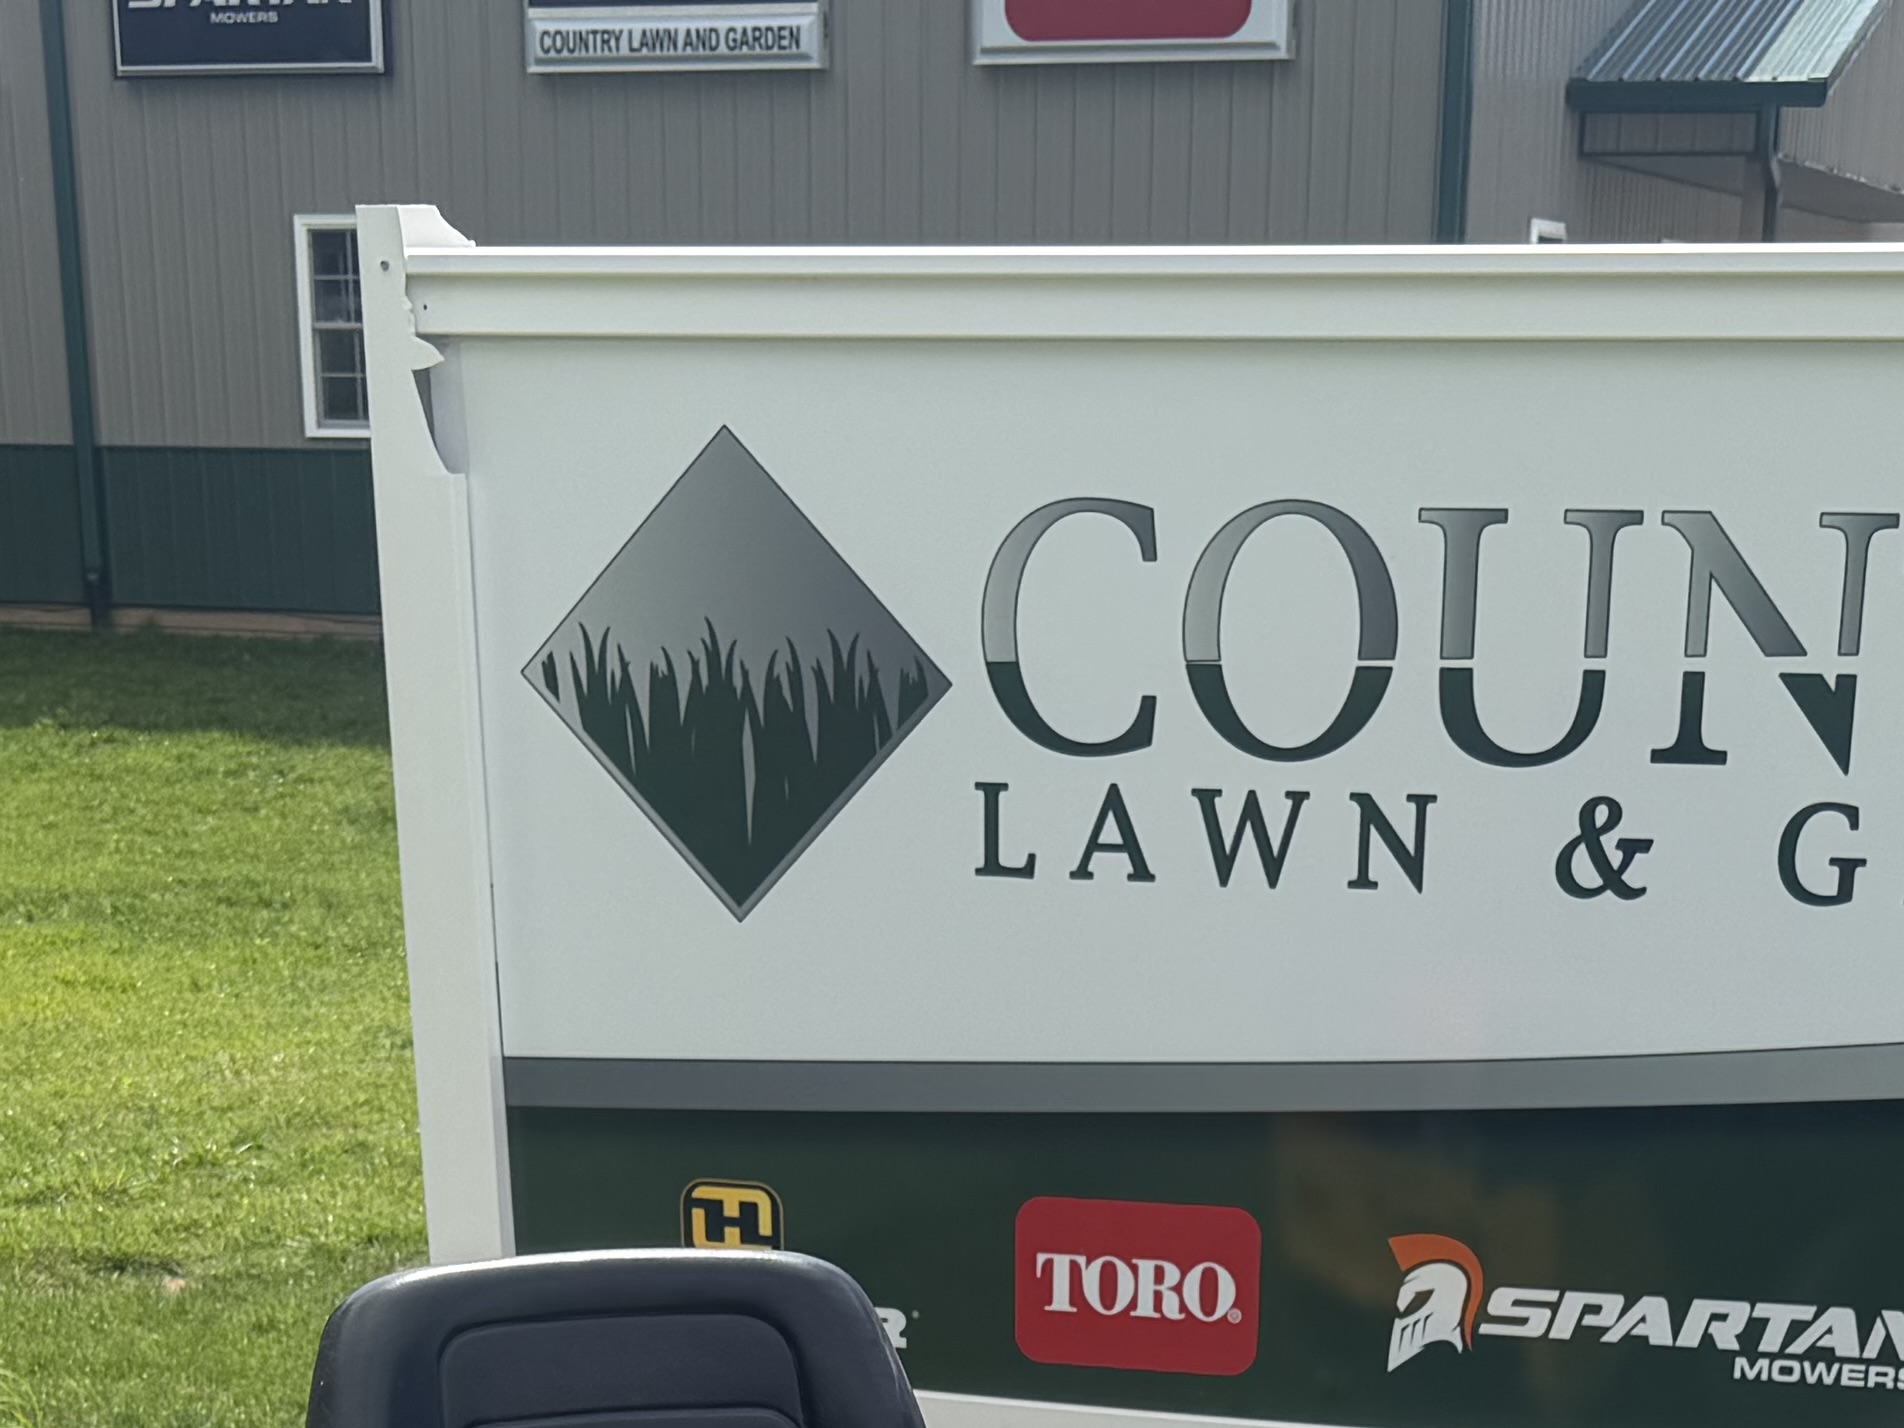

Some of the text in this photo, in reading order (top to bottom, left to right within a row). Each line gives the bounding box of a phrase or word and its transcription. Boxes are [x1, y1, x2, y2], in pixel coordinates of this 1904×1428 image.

[209, 11, 279, 25] MOWERS
[539, 25, 802, 55] COUNTRY LAWN AND GARDEN
[974, 781, 1438, 894] LAWN
[1554, 796, 1654, 900] &
[1036, 1252, 1238, 1323] TORO
